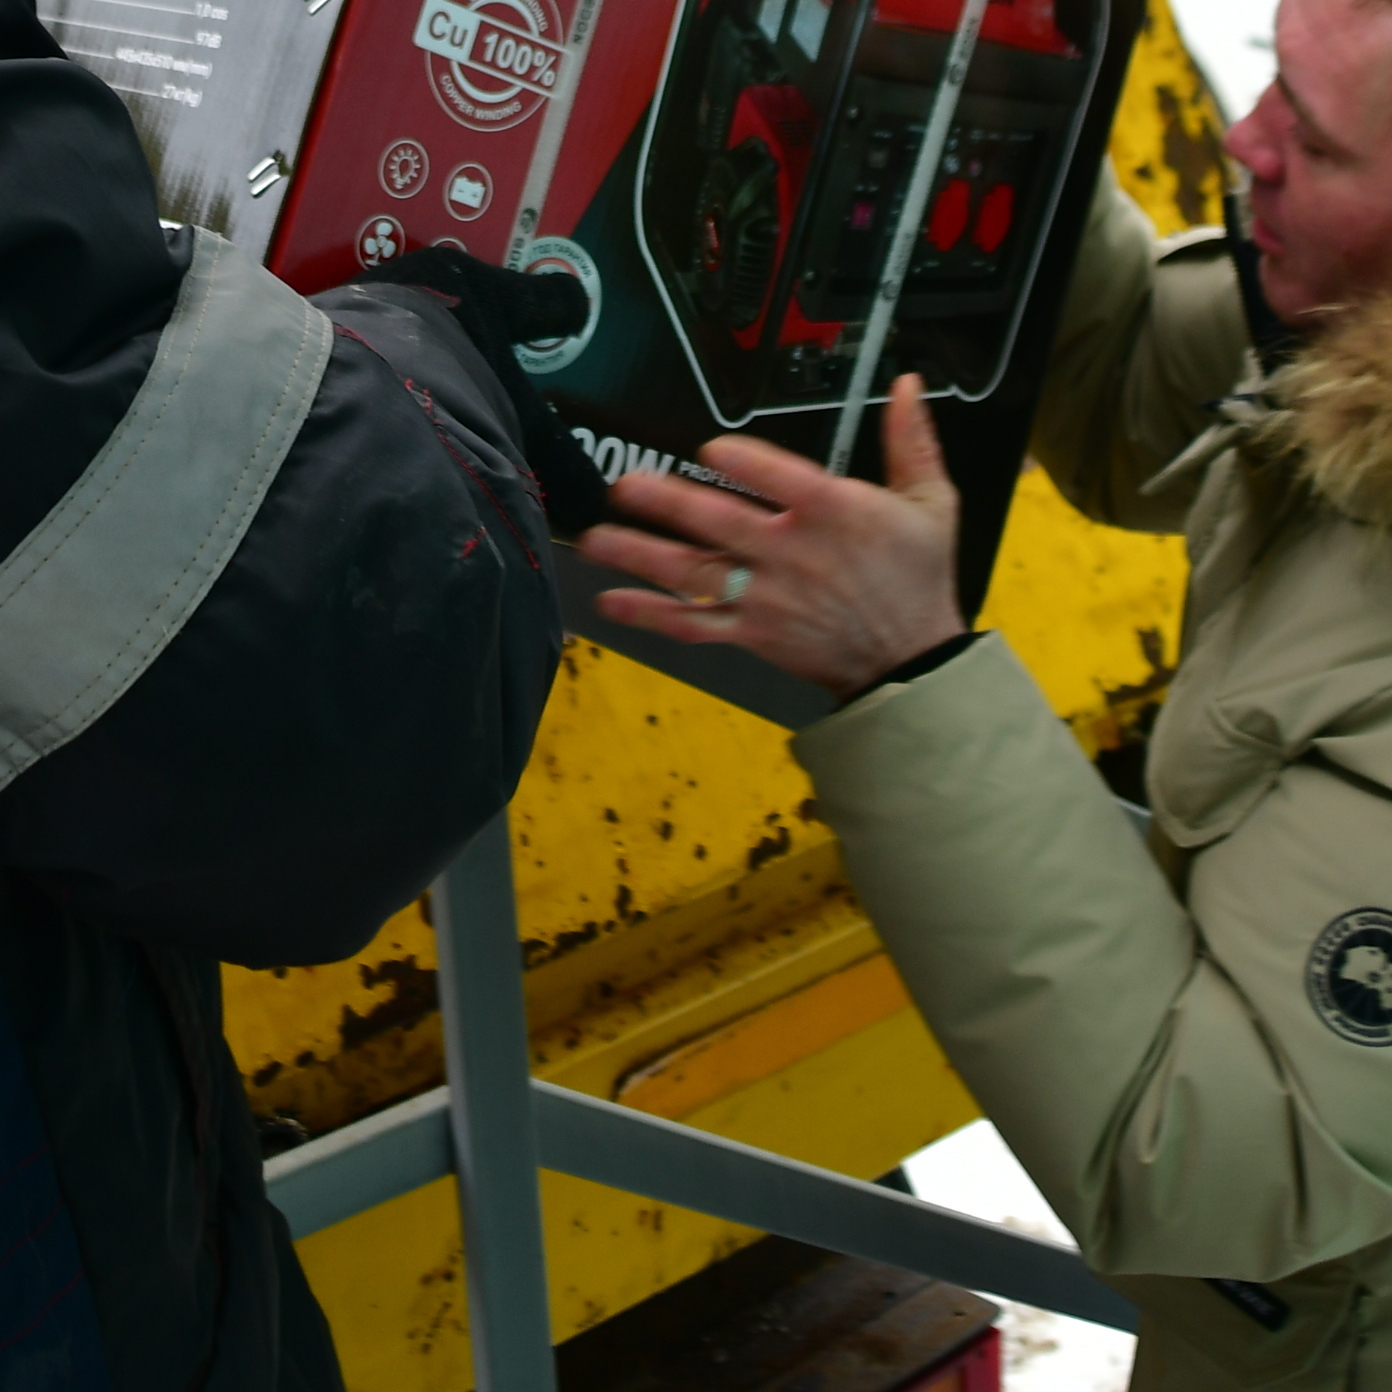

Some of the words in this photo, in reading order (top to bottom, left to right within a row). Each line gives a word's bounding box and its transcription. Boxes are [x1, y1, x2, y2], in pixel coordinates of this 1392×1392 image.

[428, 11, 469, 48] Cu
[483, 32, 557, 87] 100%
[440, 75, 475, 115] COPPER
[475, 101, 523, 121] WINDING
